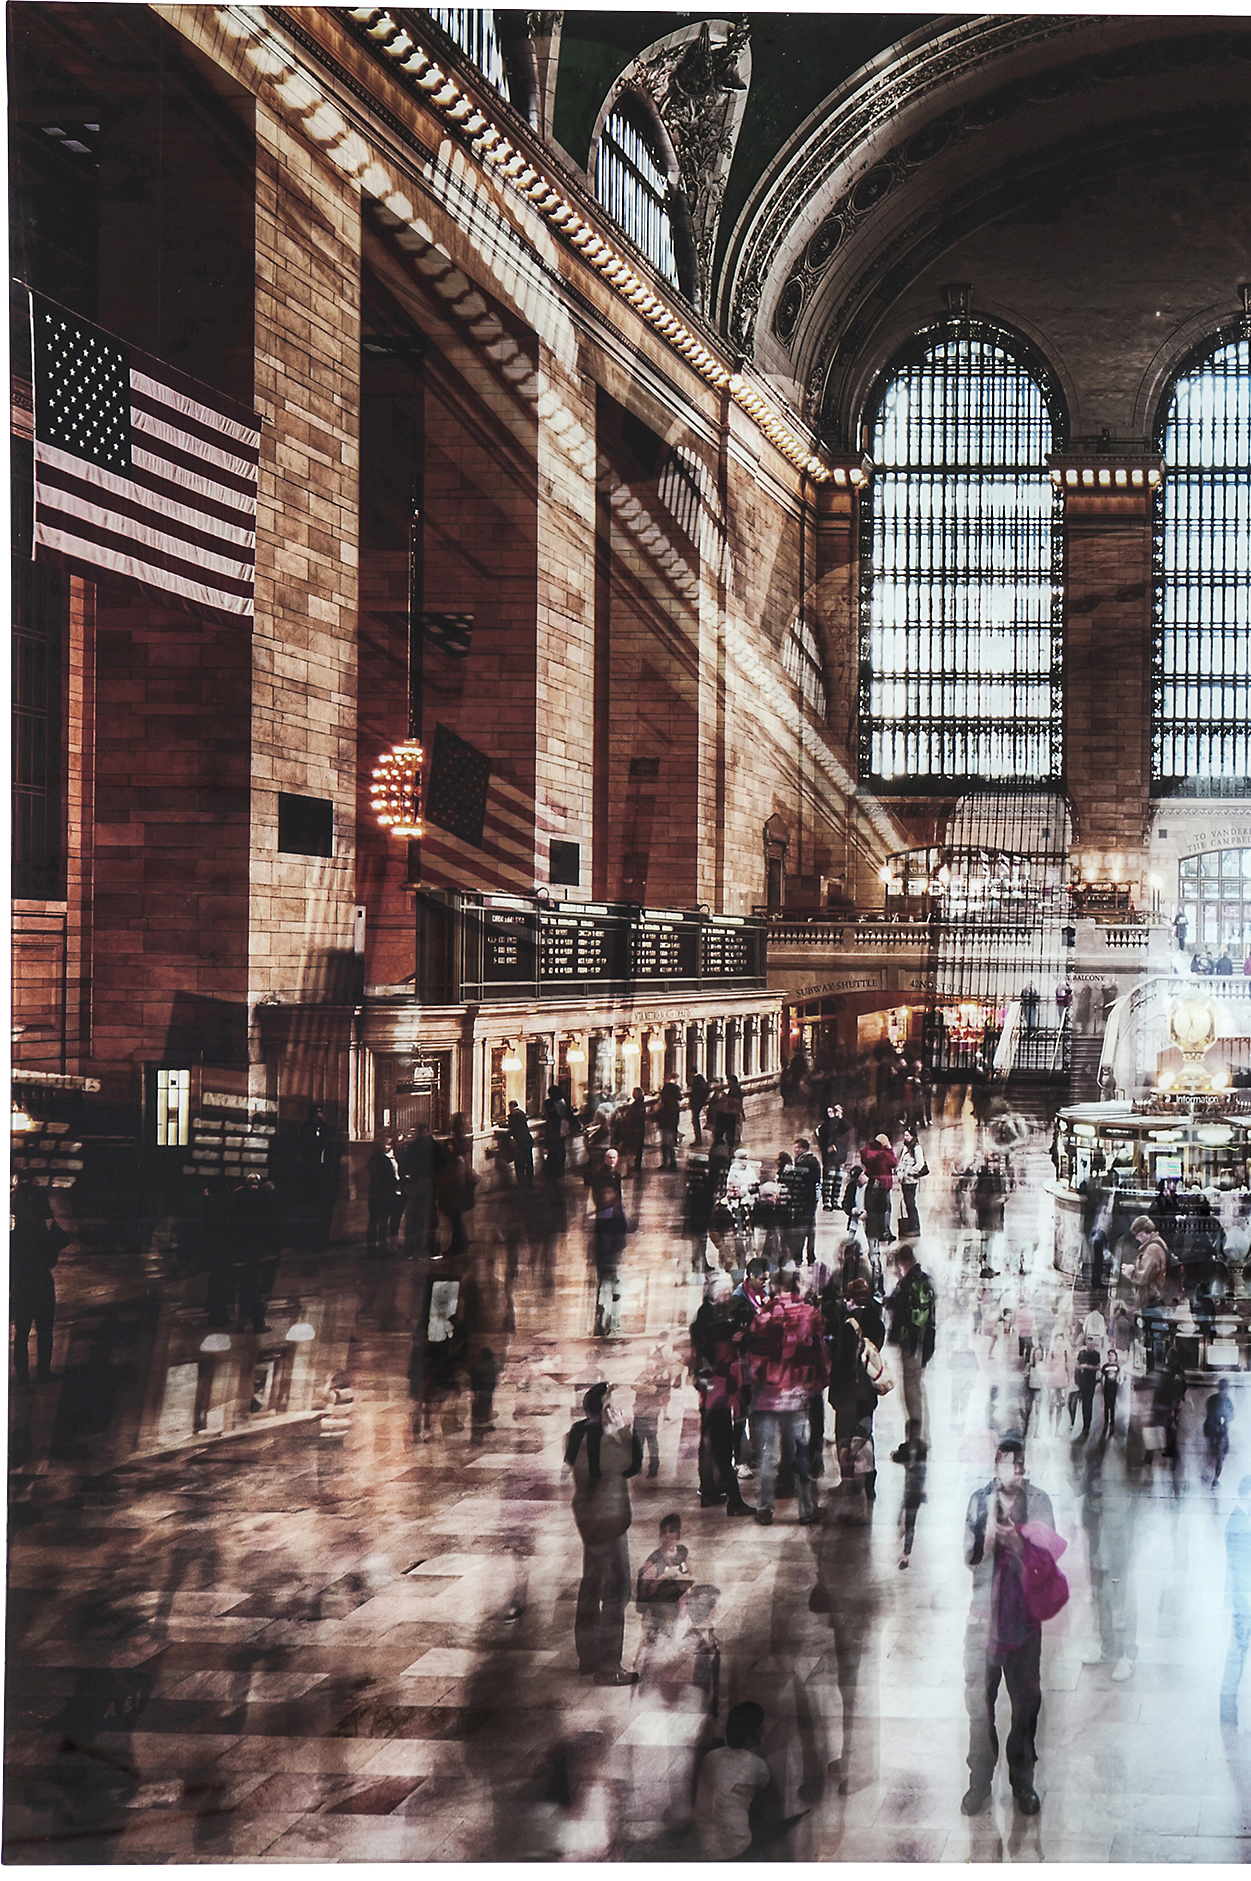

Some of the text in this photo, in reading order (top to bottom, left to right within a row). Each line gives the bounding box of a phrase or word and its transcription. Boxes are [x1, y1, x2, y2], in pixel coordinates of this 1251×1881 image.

[1194, 833, 1206, 841] TO
[1187, 843, 1206, 852] THE
[1072, 974, 1105, 982] BALCONY
[796, 979, 878, 997] SUBWAY SHUTTLE
[910, 979, 934, 990] 42ND
[1176, 1094, 1219, 1104] Information
